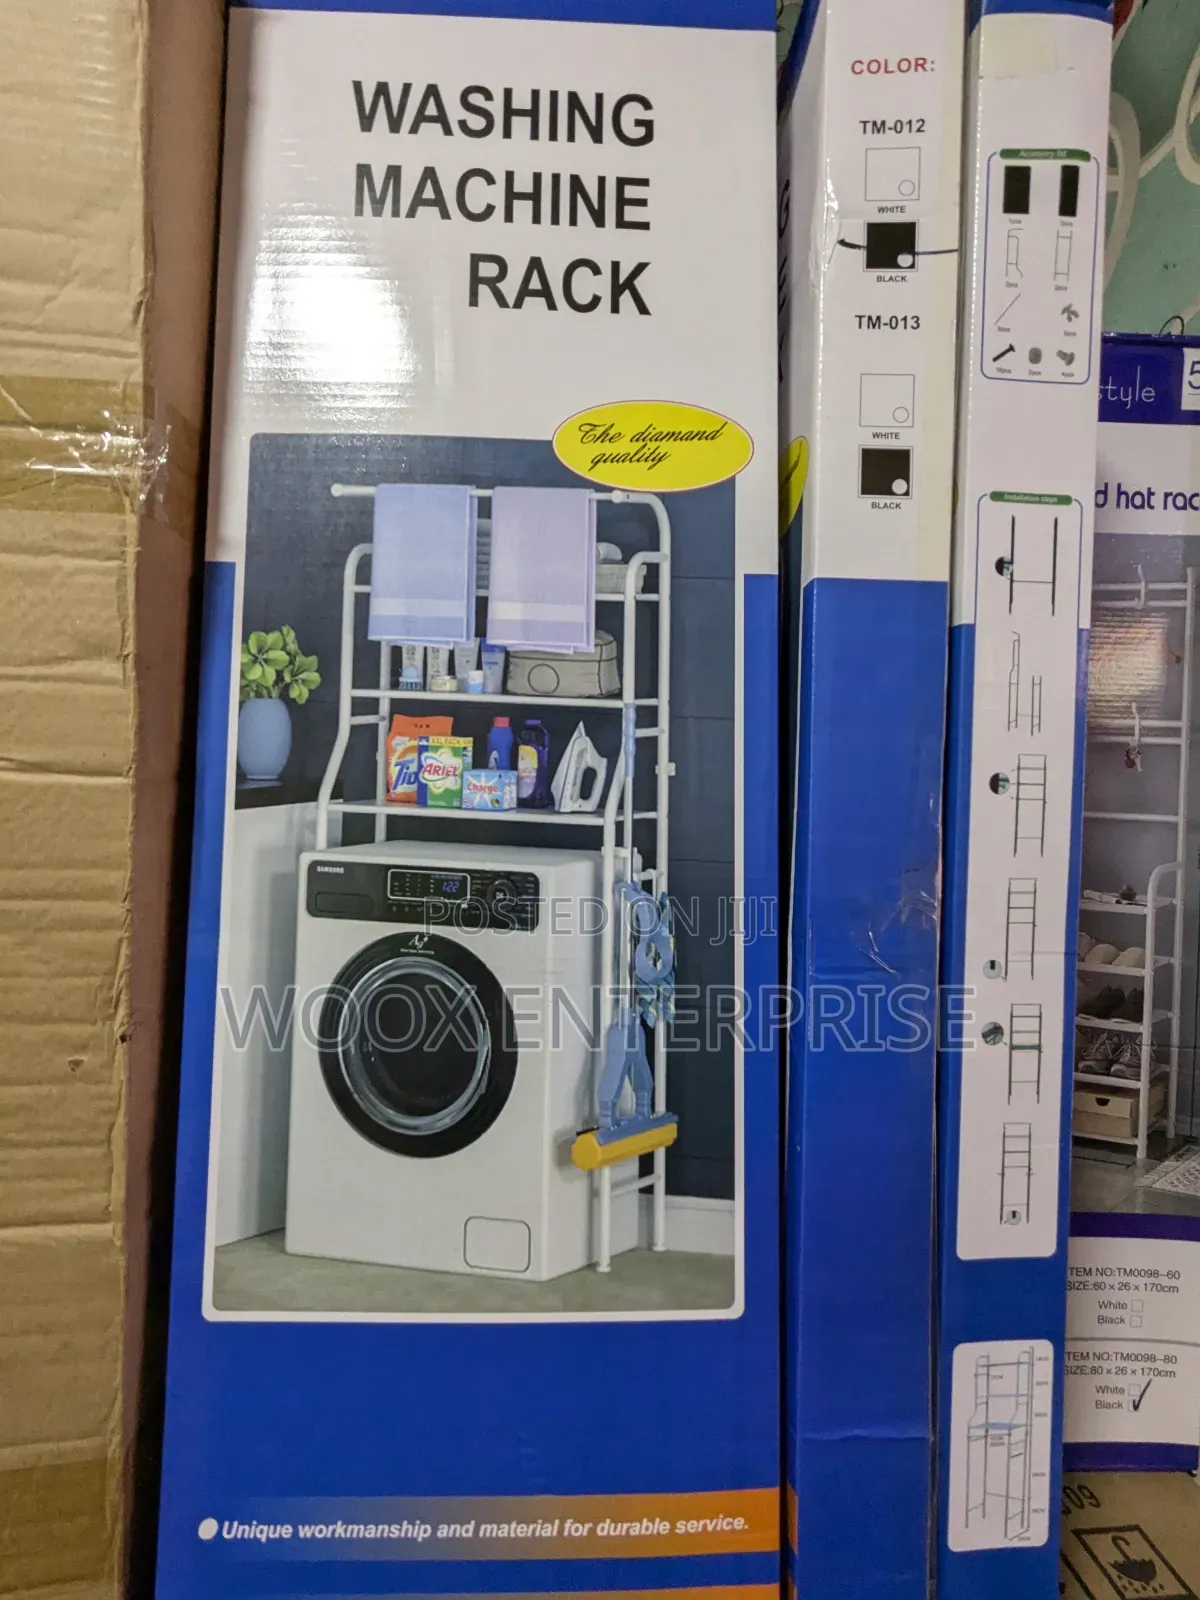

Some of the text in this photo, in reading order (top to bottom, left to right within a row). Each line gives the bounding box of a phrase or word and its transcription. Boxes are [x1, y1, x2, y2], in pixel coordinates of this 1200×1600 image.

[851, 57, 935, 75] COLOR:
[352, 79, 655, 148] WASHING
[859, 118, 926, 135] TM-012
[353, 161, 651, 231] MACHINE
[877, 205, 906, 214] WHITE
[468, 252, 653, 316] RACK
[876, 275, 907, 283] BLACK
[854, 314, 921, 330] TM-013
[578, 422, 625, 445] The
[872, 431, 901, 440] WHITE
[588, 443, 672, 472] quality
[1116, 482, 1155, 510] hat
[871, 501, 902, 510] BLACK
[421, 762, 459, 778] ARIEL
[1067, 1266, 1093, 1277] TEM
[1117, 1281, 1131, 1291] 26
[1143, 1282, 1179, 1293] 170cm
[1097, 1300, 1128, 1310] White
[1097, 1315, 1126, 1324] Black
[1065, 1351, 1090, 1361] TEM
[1114, 1366, 1128, 1376] 26
[1140, 1367, 1176, 1378] 170cm
[1095, 1384, 1125, 1394] White
[1095, 1400, 1123, 1410] Black
[221, 1514, 749, 1543] Unique workmanship and material for durable service.
